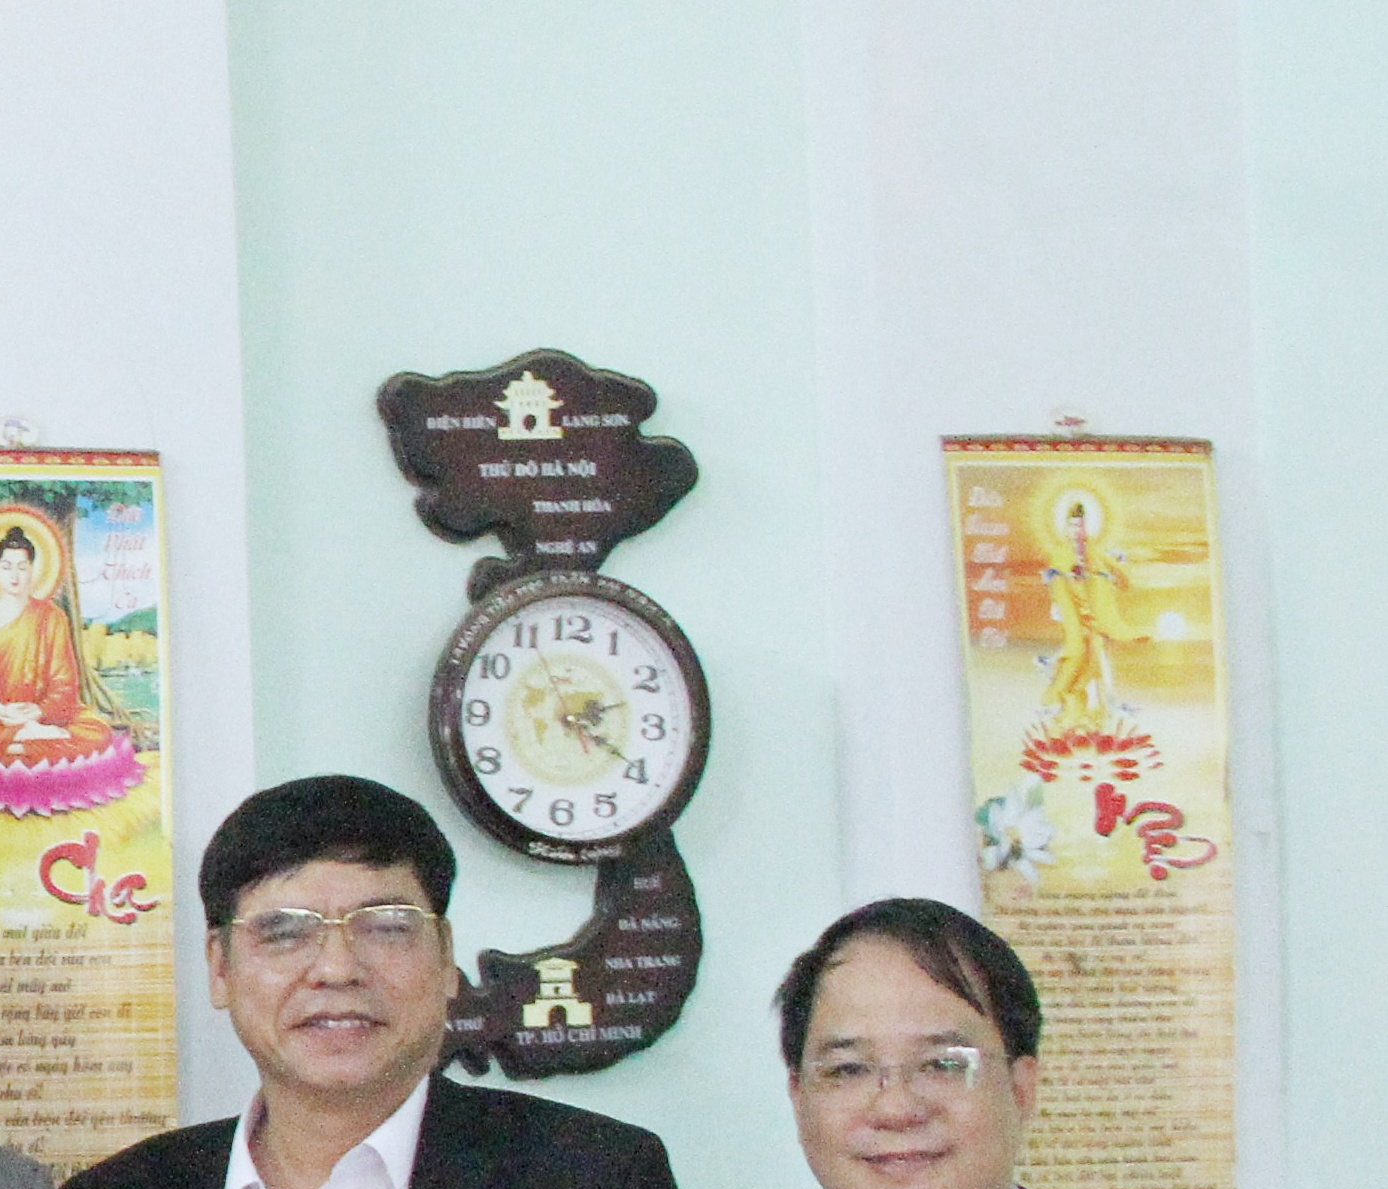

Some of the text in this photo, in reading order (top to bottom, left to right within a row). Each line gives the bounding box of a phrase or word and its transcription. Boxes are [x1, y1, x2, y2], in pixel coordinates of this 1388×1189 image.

[513, 623, 539, 649] 11
[552, 615, 593, 643] 12
[608, 631, 620, 656] 1
[478, 653, 511, 680] 10
[632, 665, 662, 693] 2
[465, 700, 491, 727] 9
[640, 714, 666, 741] 3
[475, 746, 502, 775] 8
[624, 757, 649, 785] 4
[508, 787, 534, 814] 7
[549, 799, 574, 826] 6
[592, 791, 617, 818] 5
